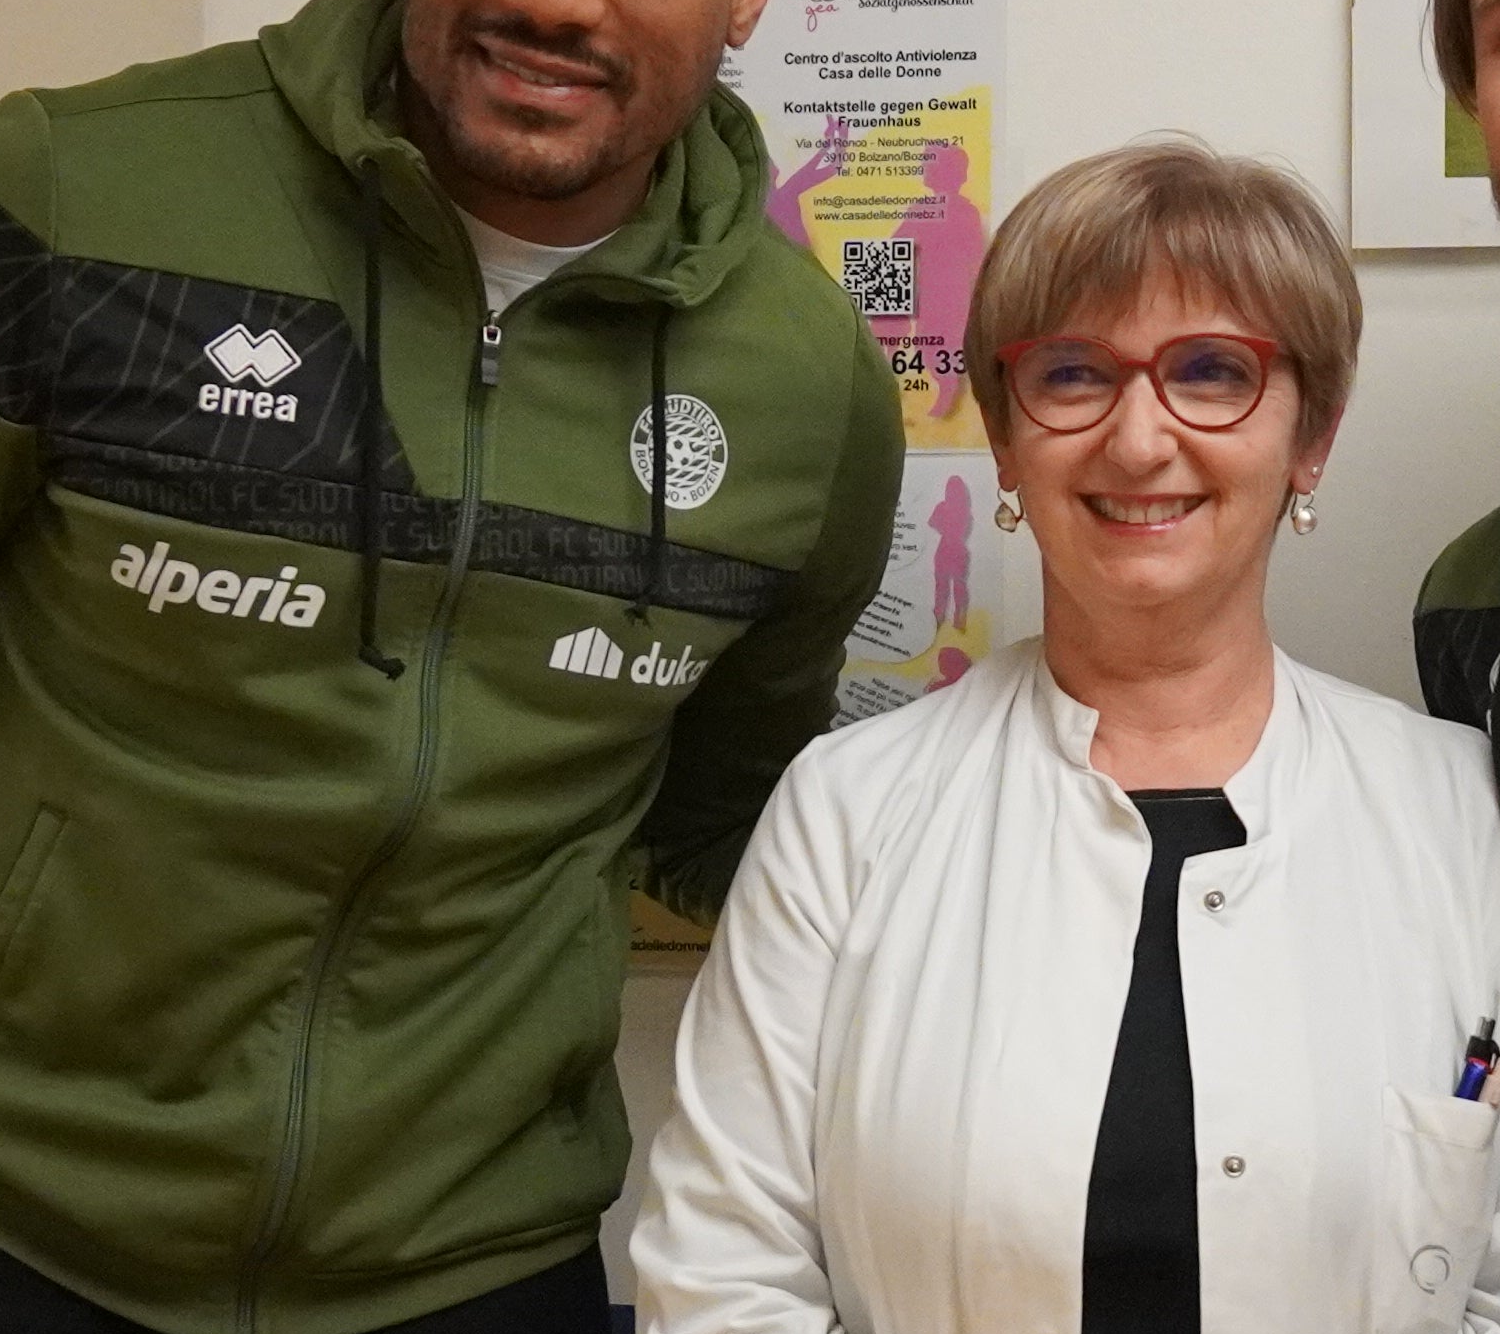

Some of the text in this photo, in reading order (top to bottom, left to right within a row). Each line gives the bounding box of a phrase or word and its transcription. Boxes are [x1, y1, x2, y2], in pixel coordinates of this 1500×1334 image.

[805, 3, 840, 33] gea
[784, 49, 977, 65] Centro d'ascolto Antiviolenza
[818, 65, 942, 80] Casa delle Donne
[784, 98, 977, 114] Kontaktstelle gegen Gewalt
[838, 115, 921, 128] Frauenhaus
[796, 139, 812, 148] Via
[815, 138, 831, 148] del
[834, 138, 867, 148] Ronco
[877, 136, 949, 149] Neubruchweg
[952, 136, 964, 146] 21
[823, 151, 937, 163] 39100 Bolzano/Bozen
[856, 166, 882, 176] 0471
[886, 165, 924, 176] 513399
[875, 335, 945, 348] mergenza
[892, 349, 925, 375] 64
[903, 378, 929, 391] 24h
[664, 398, 724, 452] ÜDTIROL
[689, 464, 720, 502] BOZEN
[110, 541, 327, 629] alperia
